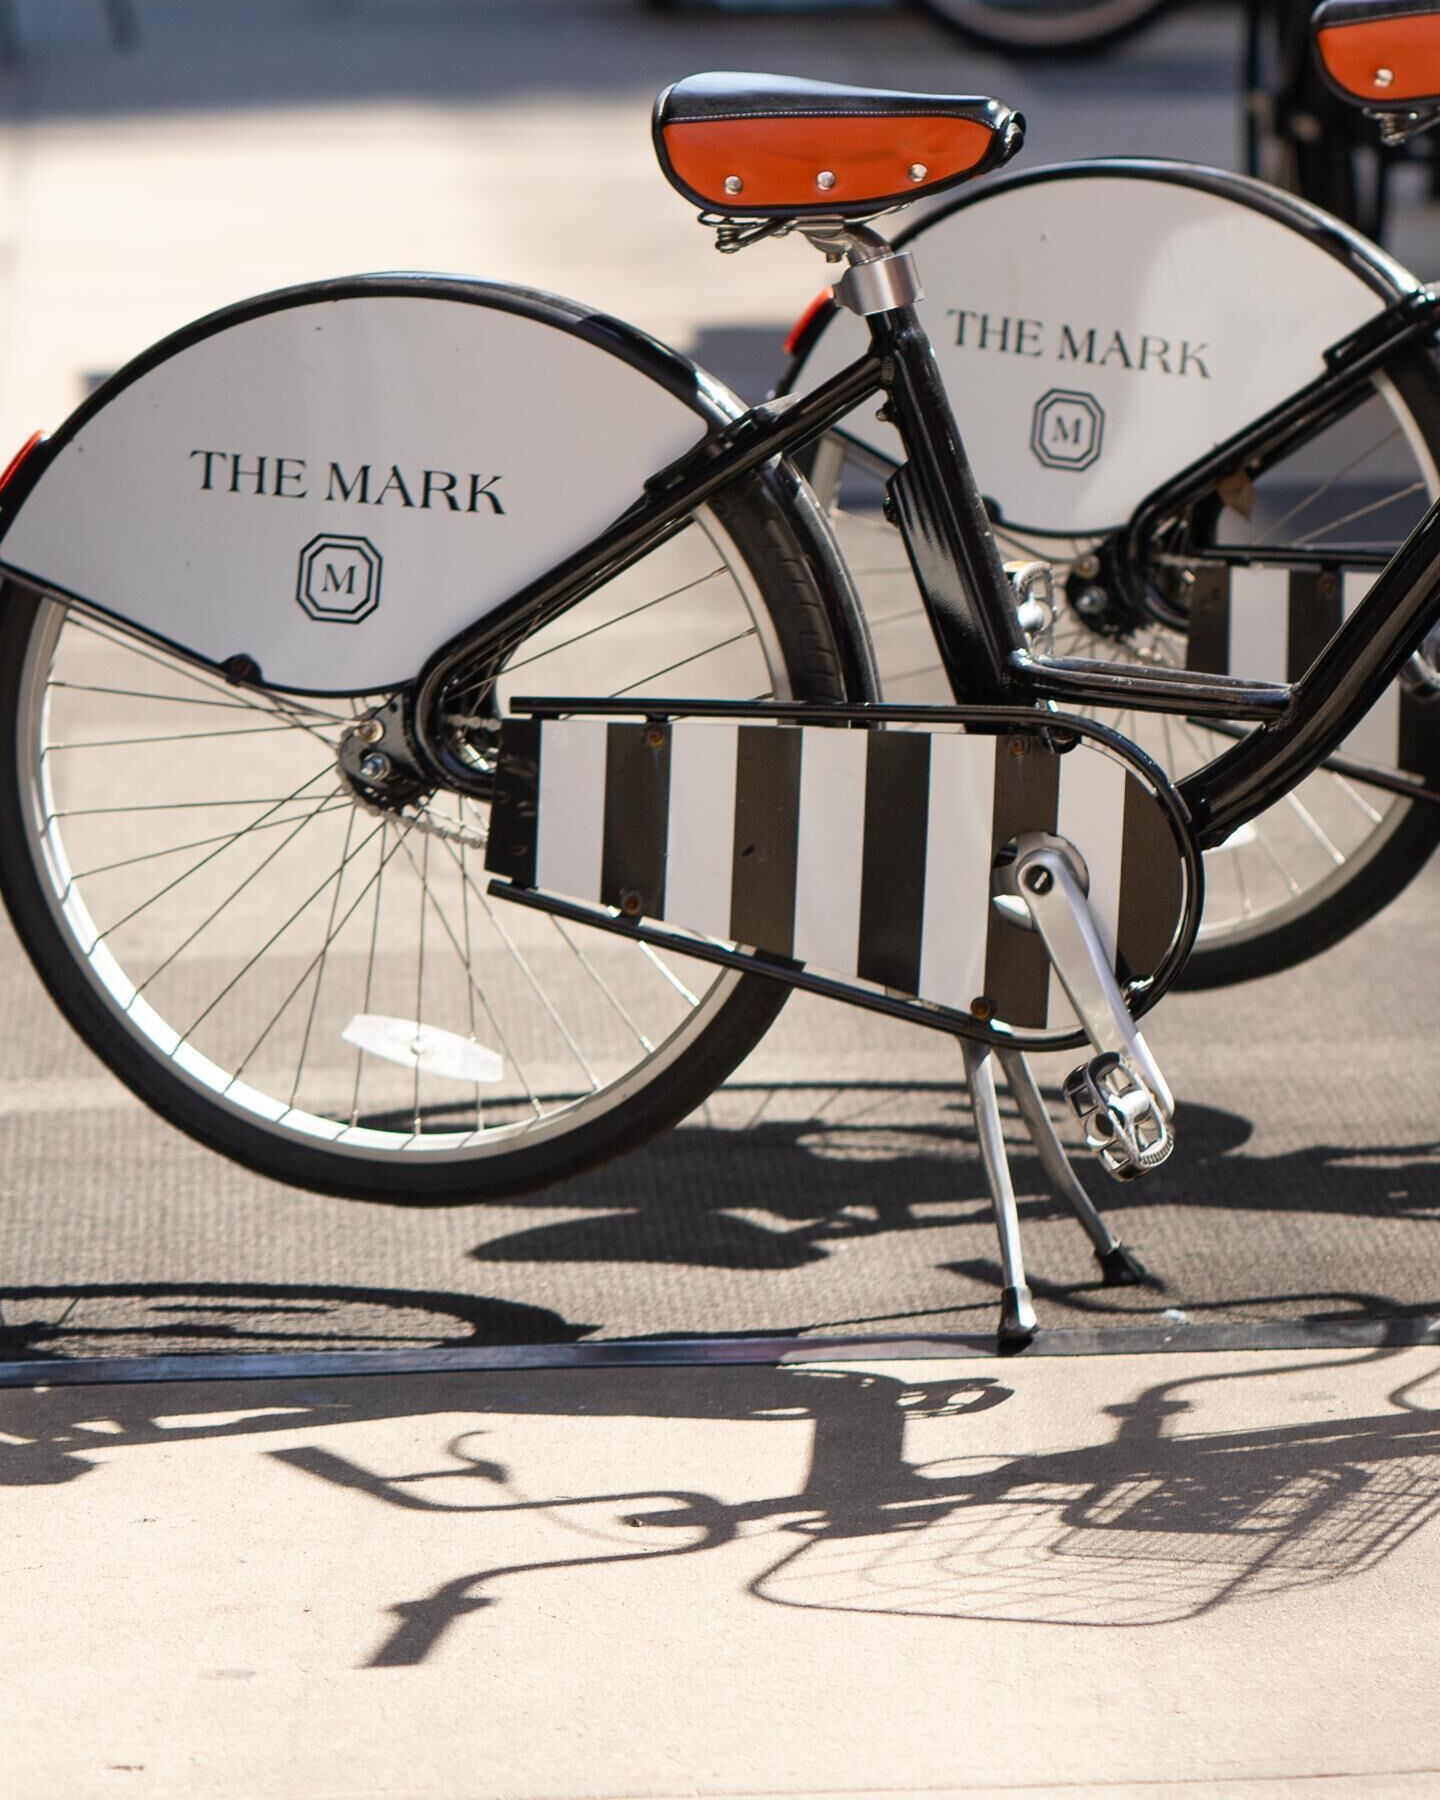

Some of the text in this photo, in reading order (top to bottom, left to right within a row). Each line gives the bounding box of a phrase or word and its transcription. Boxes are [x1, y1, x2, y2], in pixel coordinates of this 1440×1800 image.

[945, 308, 1212, 380] THE MARK
[1052, 415, 1082, 445] M
[188, 449, 507, 516] THE MARK
[320, 562, 358, 595] M
